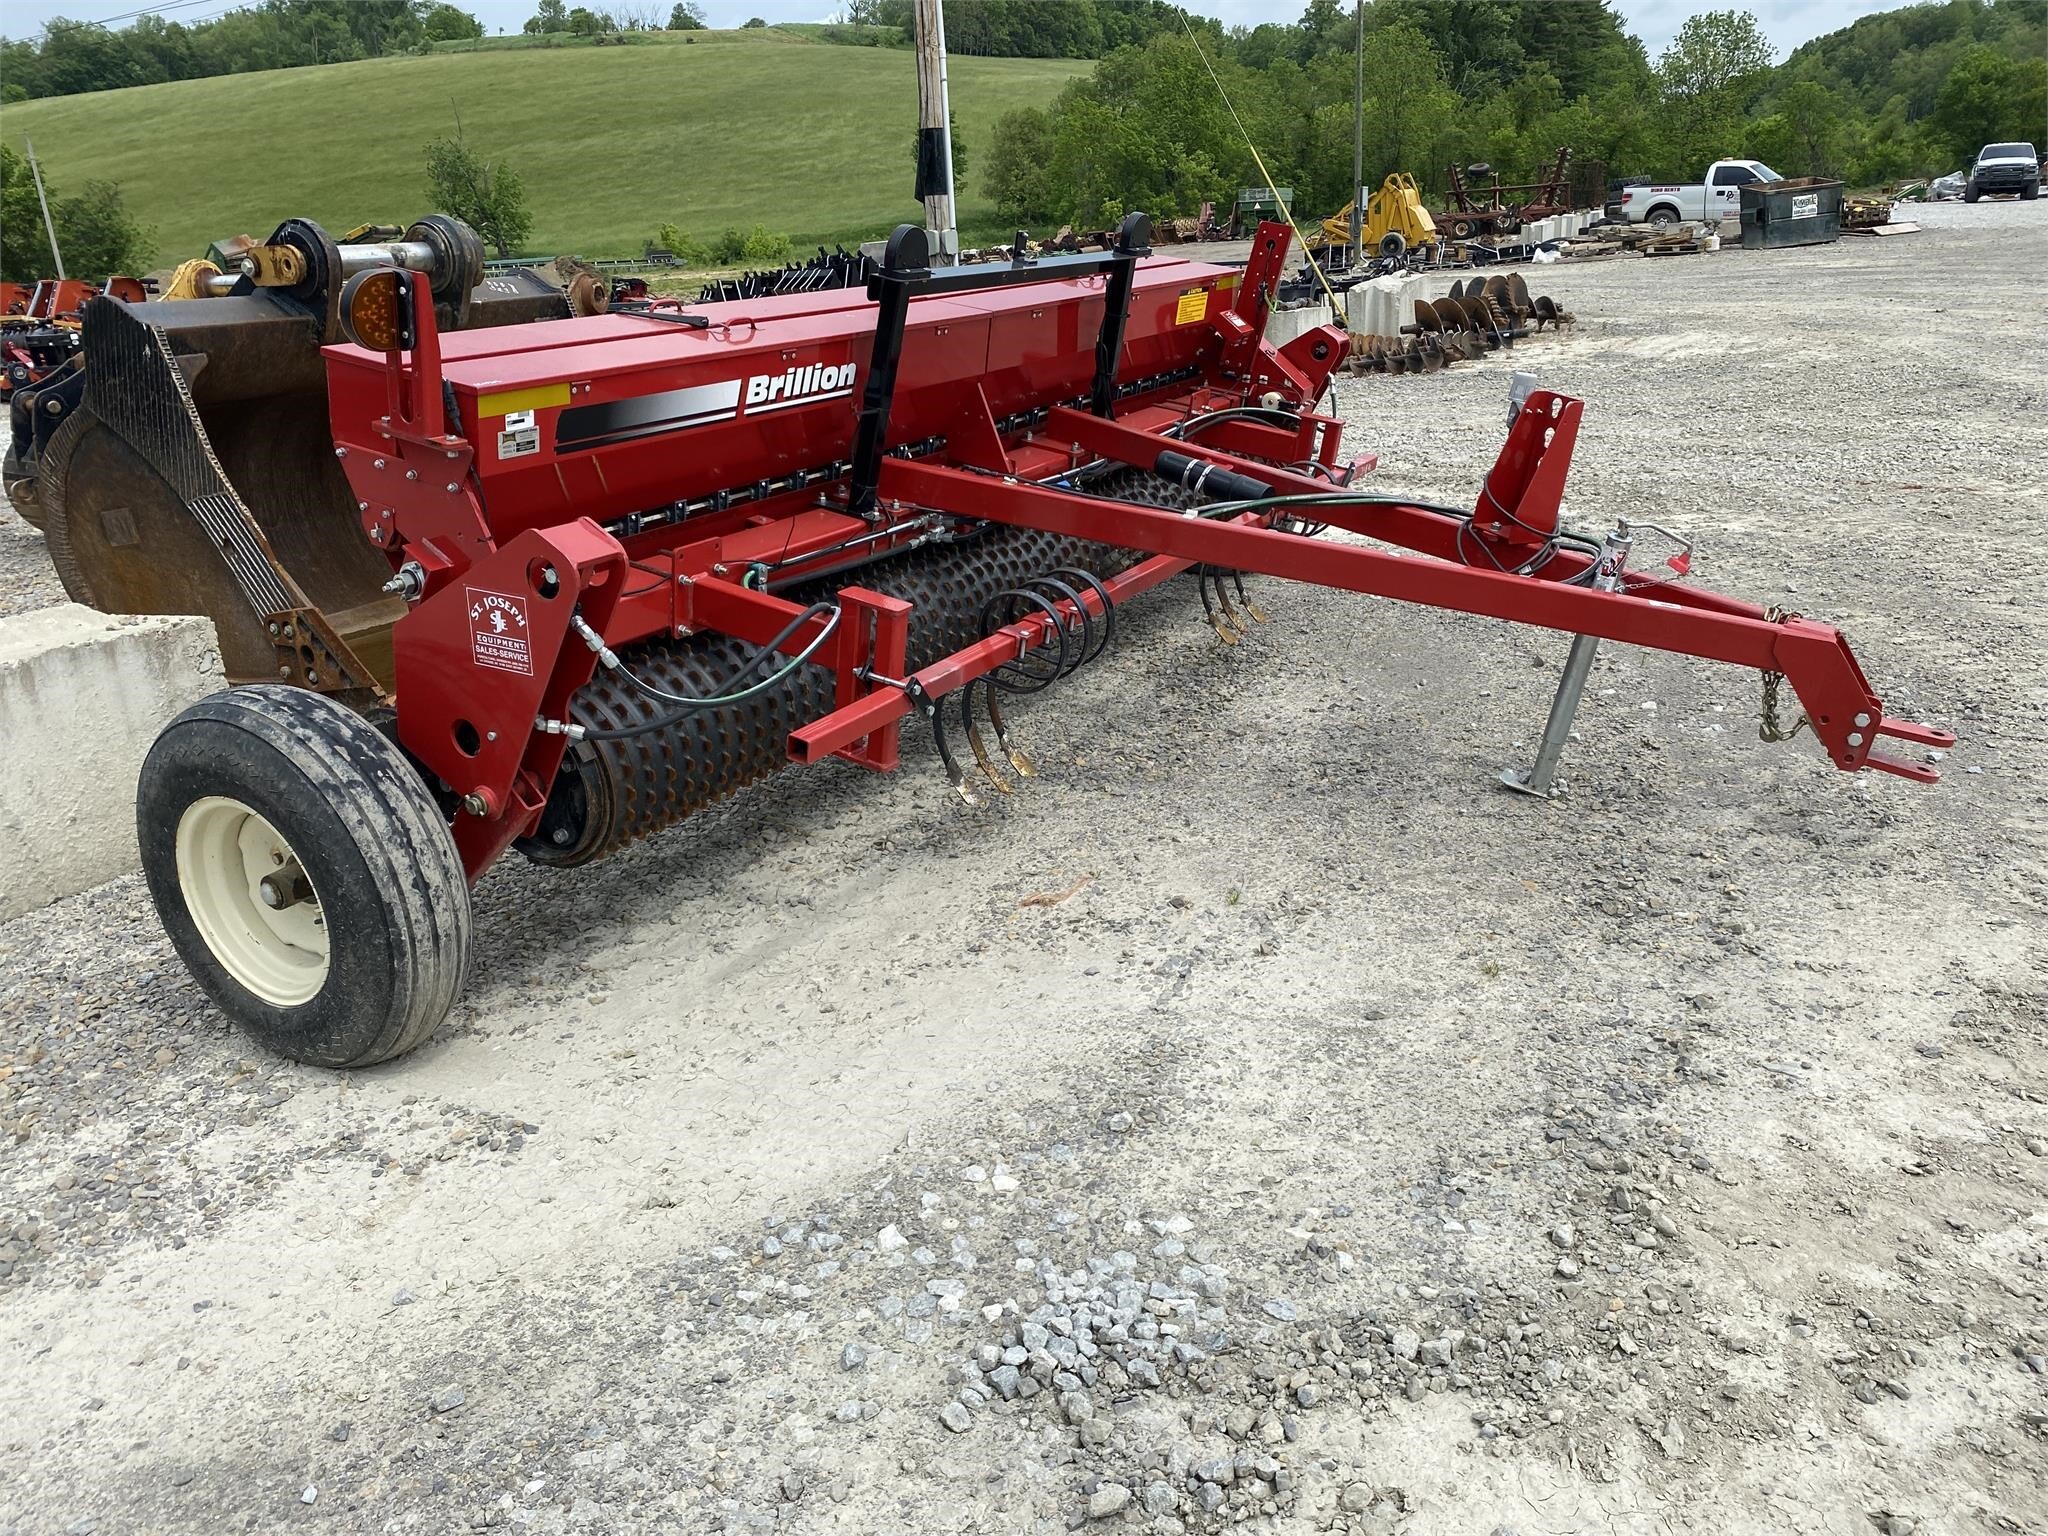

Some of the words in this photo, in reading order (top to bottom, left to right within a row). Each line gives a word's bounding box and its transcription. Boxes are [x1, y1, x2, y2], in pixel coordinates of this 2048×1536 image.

[746, 362, 857, 405] Brillion
[471, 603, 484, 621] ST.
[483, 596, 526, 627] JOSEPH
[475, 645, 529, 662] SALES-SERVICE
